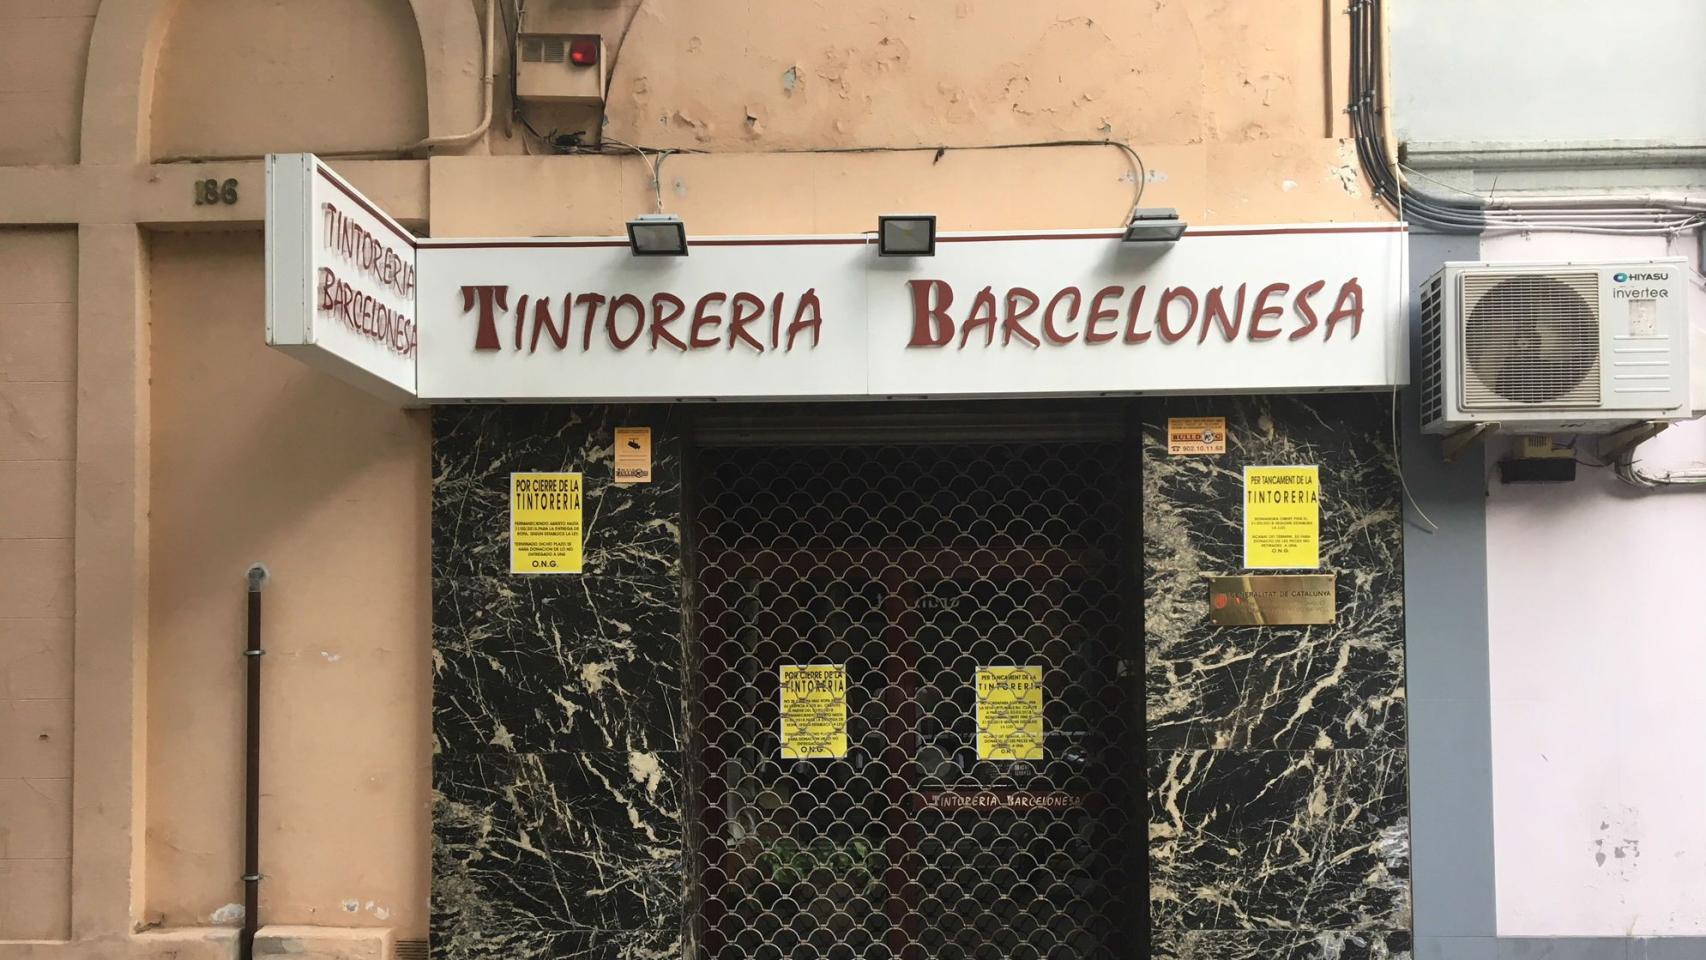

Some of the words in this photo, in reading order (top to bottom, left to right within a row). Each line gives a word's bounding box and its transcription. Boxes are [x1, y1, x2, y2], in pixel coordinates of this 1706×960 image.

[195, 178, 238, 205] 186
[322, 203, 414, 296] TINTORERIA
[1629, 273, 1669, 281] HIYASU
[318, 267, 417, 356] BARCELONESA
[462, 285, 823, 352] TINTORERIA
[908, 277, 1365, 348] BARCELONESA
[516, 480, 530, 492] POR
[533, 480, 556, 492] CIERRE
[559, 480, 568, 492] DE
[570, 480, 579, 492] LA
[1250, 476, 1261, 484] PER
[1262, 476, 1295, 484] TANCAMENT
[1296, 476, 1304, 484] DE
[1305, 476, 1312, 484] LA
[517, 493, 580, 510] TINTORERIA
[1248, 490, 1317, 503] TINTORERIA
